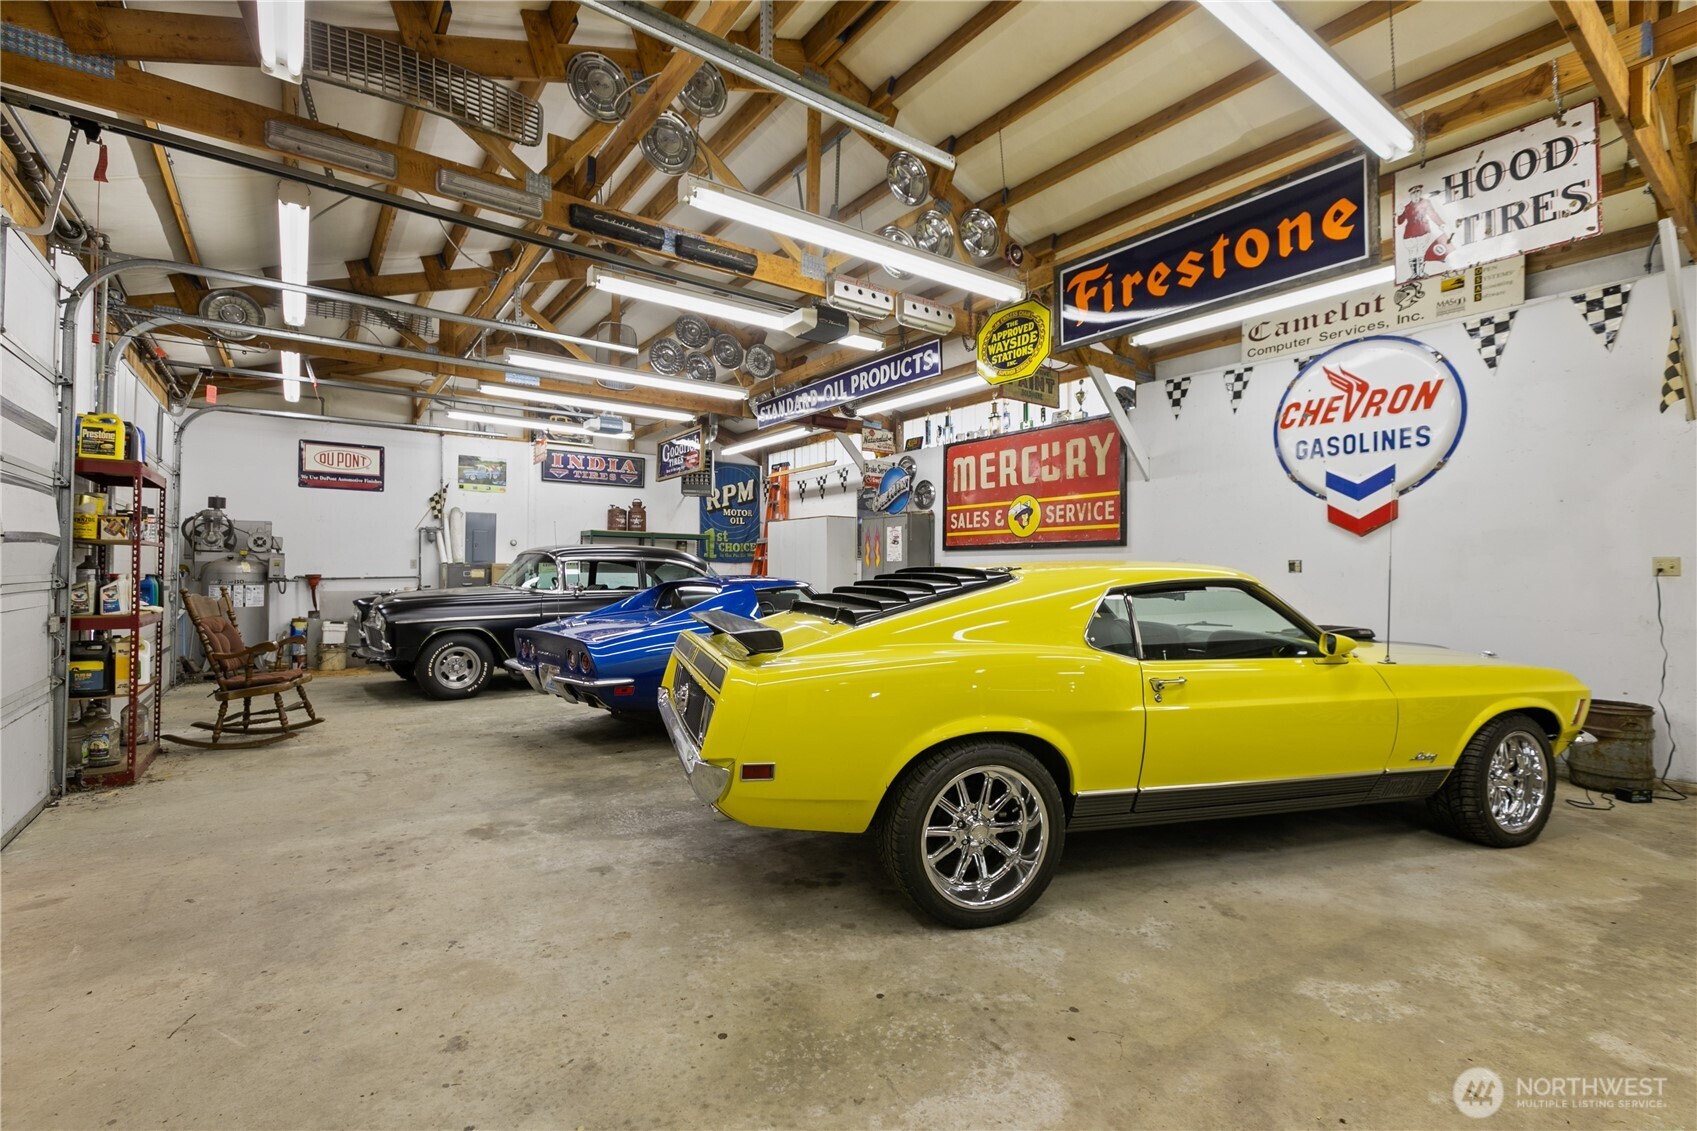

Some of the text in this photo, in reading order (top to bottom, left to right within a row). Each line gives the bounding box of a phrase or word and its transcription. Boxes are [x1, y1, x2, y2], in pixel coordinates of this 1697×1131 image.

[1442, 135, 1578, 205] HOOD
[1460, 179, 1591, 246] TIRES
[1066, 197, 1358, 327] Firestone
[1006, 320, 1019, 328] THE
[1248, 294, 1386, 342] Camelot
[988, 330, 1038, 355] WAYSIDE
[991, 322, 1035, 343] APPROVED
[1247, 312, 1425, 359] Computer Services, Inc.
[991, 344, 1034, 365] STATIONS
[760, 349, 933, 422] STANDARD OIL PRODUCTS
[1008, 376, 1056, 394] AINT
[1280, 375, 1445, 430] CHEVRON
[82, 429, 116, 440] Prestone
[1295, 425, 1431, 460] GASOLINES
[337, 452, 367, 468] PONT
[551, 452, 638, 474] INDIA
[953, 432, 1115, 493] MERCURY
[573, 470, 617, 481] TIRES
[706, 479, 755, 511] RPM
[723, 508, 753, 517] MOTOR
[730, 517, 745, 525] OIL
[950, 500, 1115, 529] SALES & SERVICE
[718, 542, 757, 553] CHOICE
